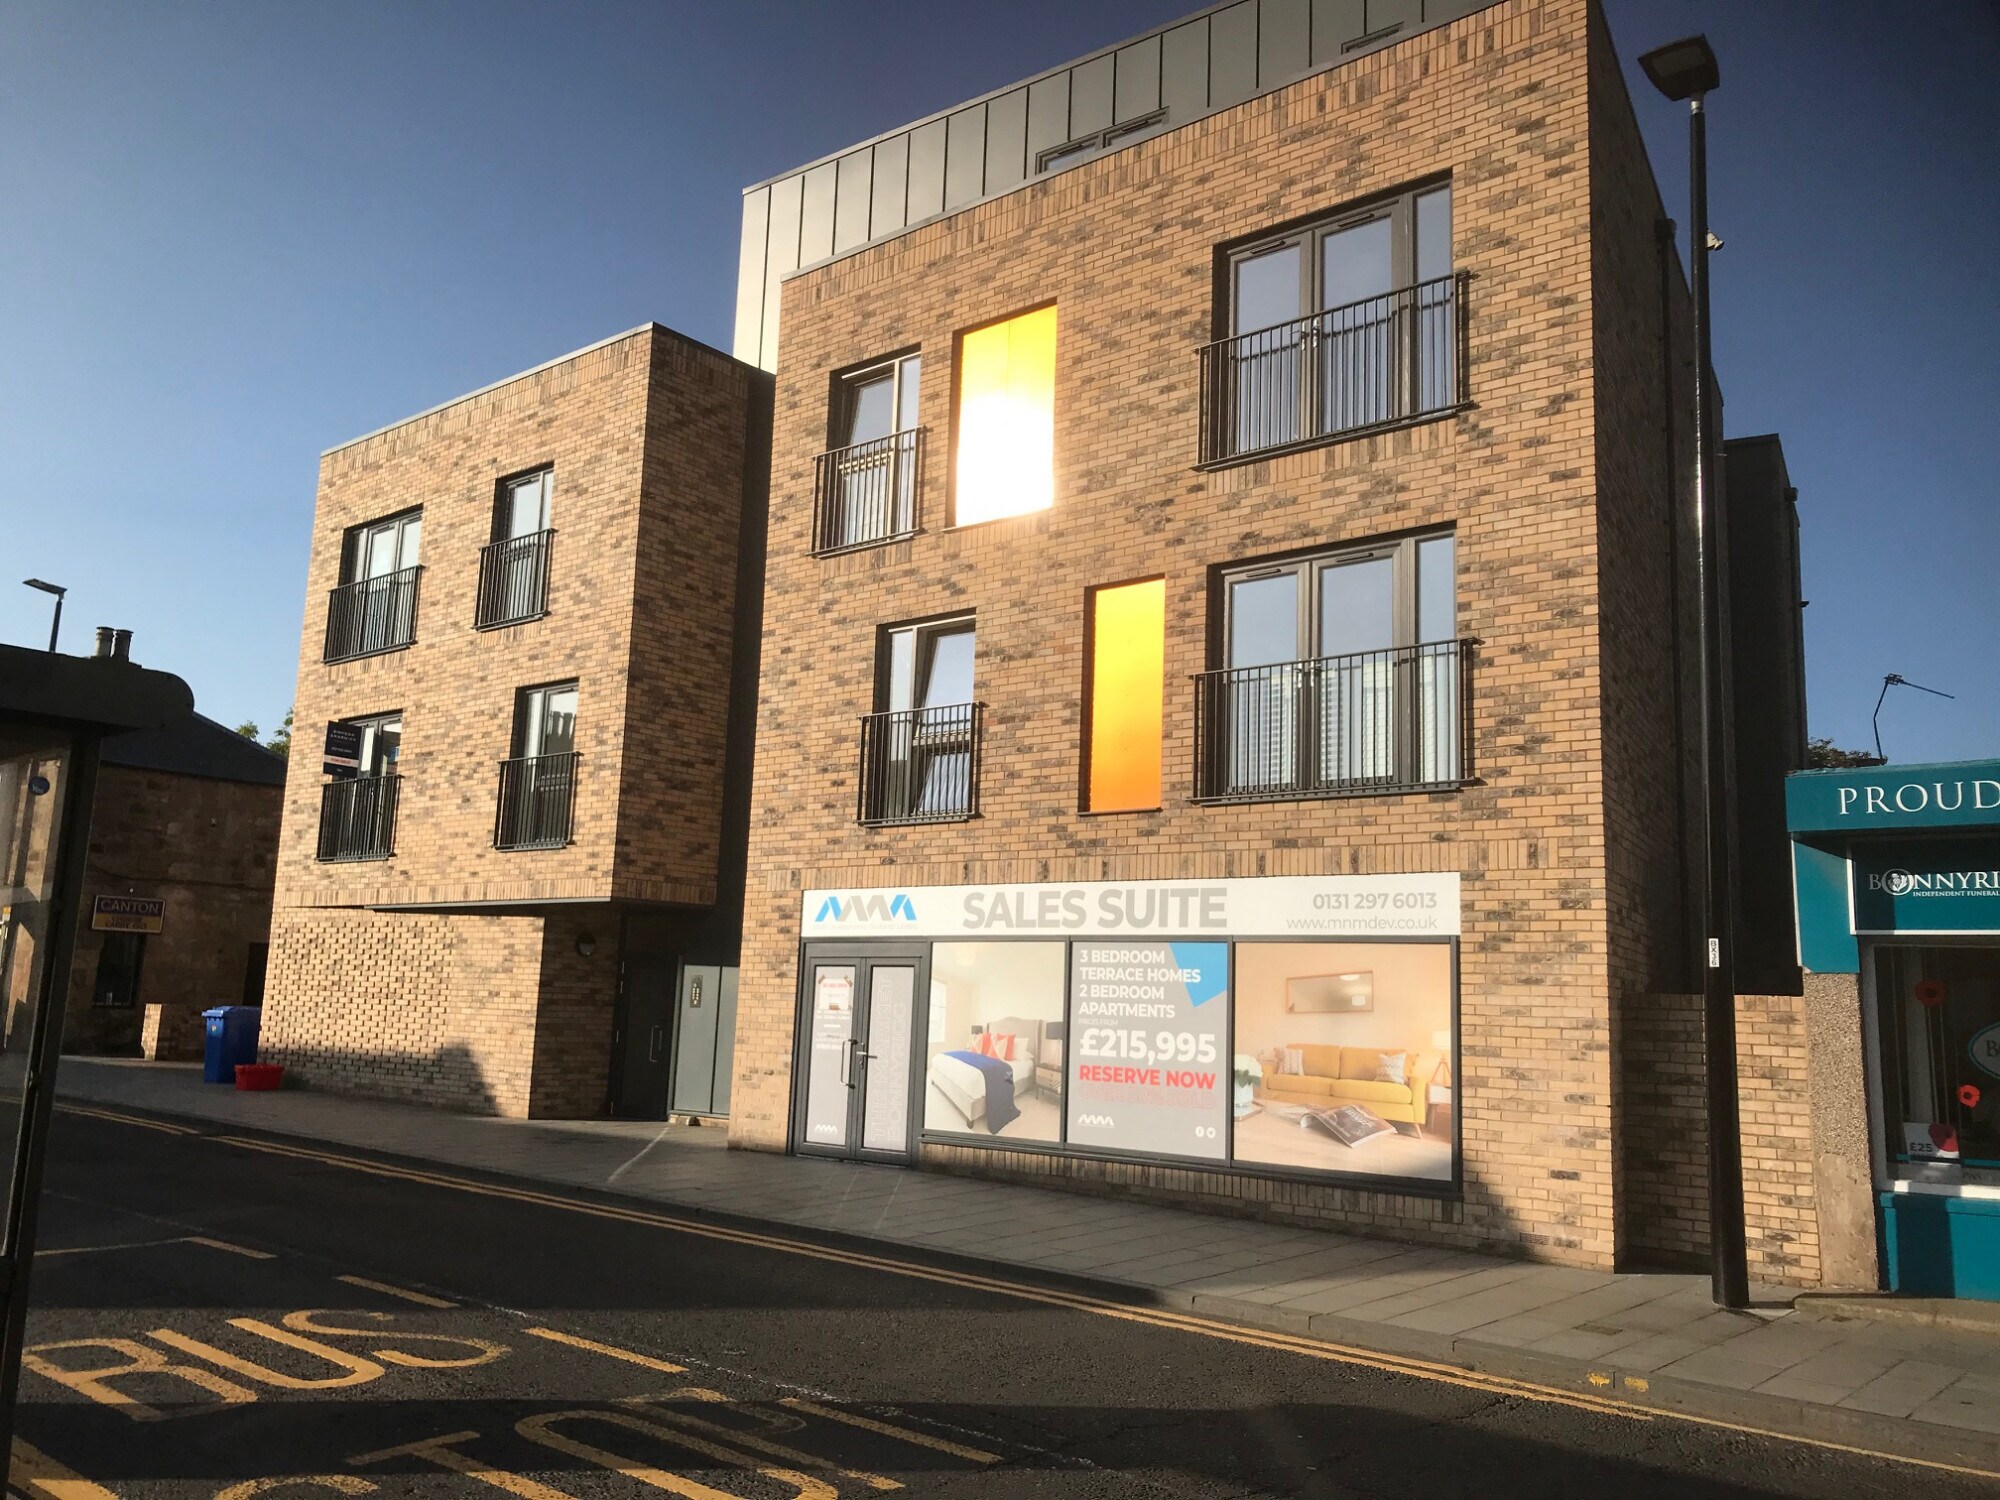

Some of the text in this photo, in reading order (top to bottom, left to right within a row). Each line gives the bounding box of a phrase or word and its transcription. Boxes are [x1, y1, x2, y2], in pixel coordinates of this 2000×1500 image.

[1837, 780, 2000, 815] PROUD
[1313, 891, 1438, 911] 0131 297 6013
[1912, 890, 1966, 898] INDEPENDENT
[100, 899, 159, 914] CANTON
[962, 887, 1228, 930] SALES SUITE
[1286, 915, 1438, 931] www.mnmdev.co.uk
[1079, 949, 1165, 964] 3 BEDROOM
[1079, 967, 1202, 983] TERRACE HOMES
[1079, 984, 1165, 1000] 2 BEDROOM
[1078, 1001, 1176, 1018] APARTMENTS
[1100, 1018, 1119, 1027] FROM
[1079, 1027, 1217, 1066] £215,995
[1079, 1064, 1217, 1090] RESERVE NOW
[1909, 1142, 1933, 1153] £25
[22, 1308, 512, 1422] BUS
